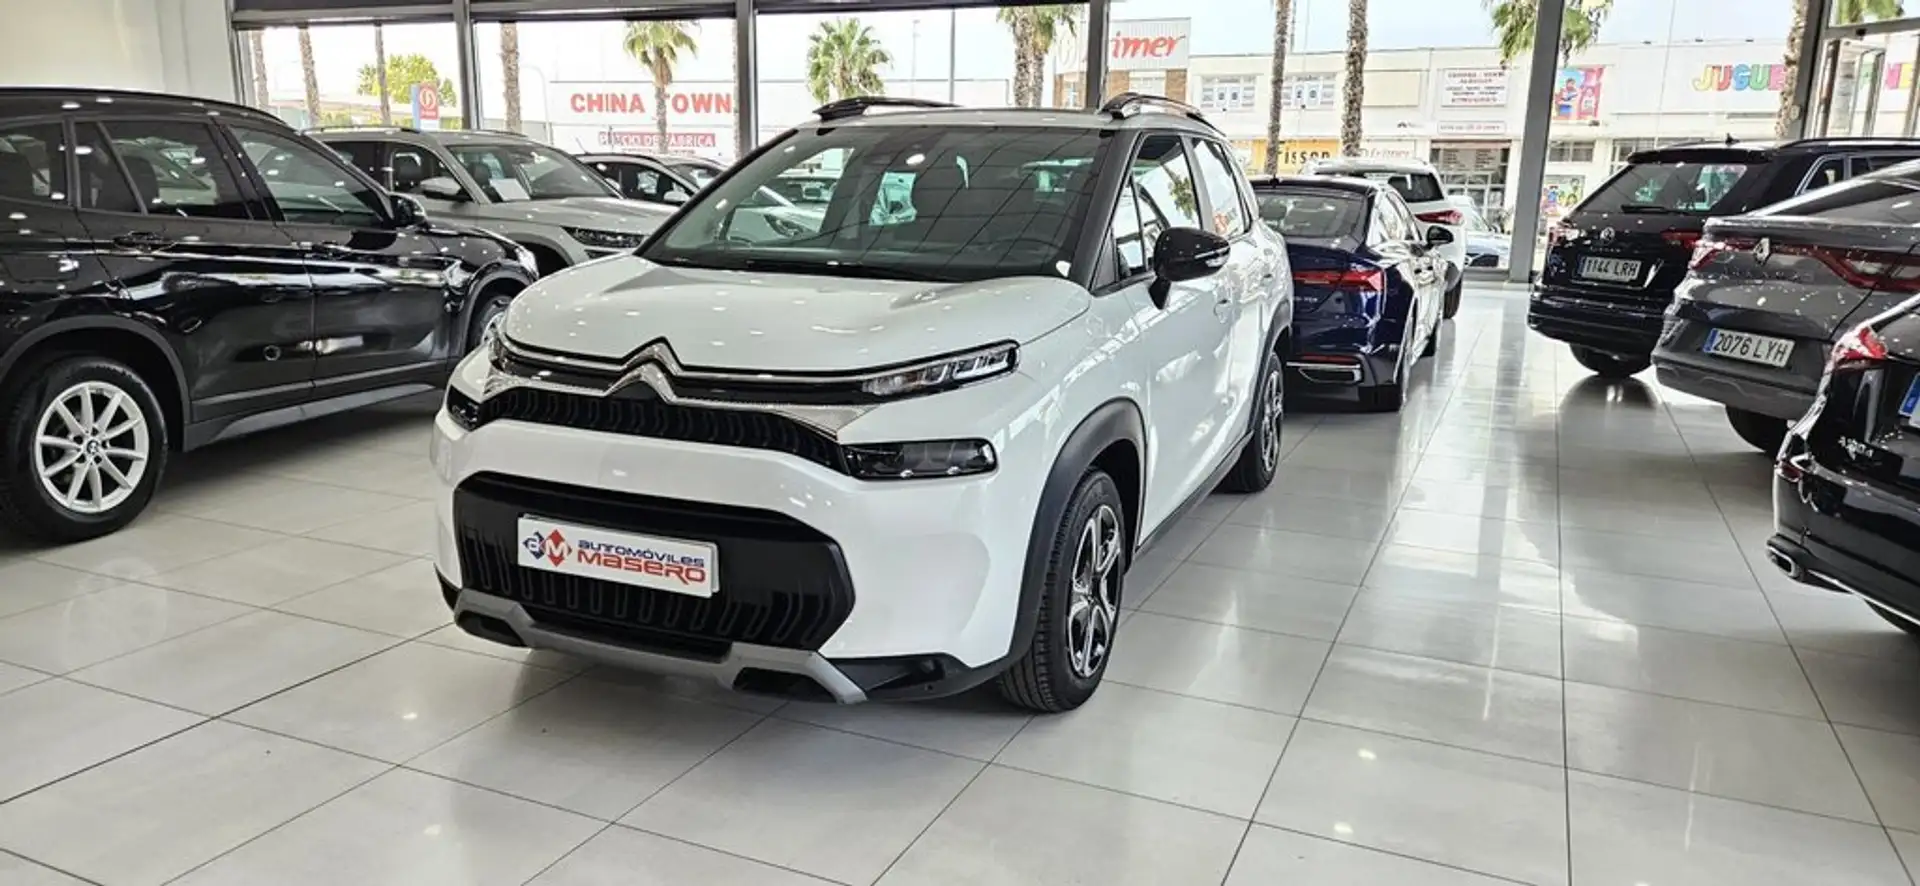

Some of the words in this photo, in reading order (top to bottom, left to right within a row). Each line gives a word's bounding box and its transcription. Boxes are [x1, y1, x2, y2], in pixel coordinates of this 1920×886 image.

[570, 92, 645, 114] CHINA
[662, 93, 732, 114] OWN
[664, 134, 714, 147] ABRICA
[1713, 333, 1753, 356] 2076
[1752, 339, 1789, 363] LYH
